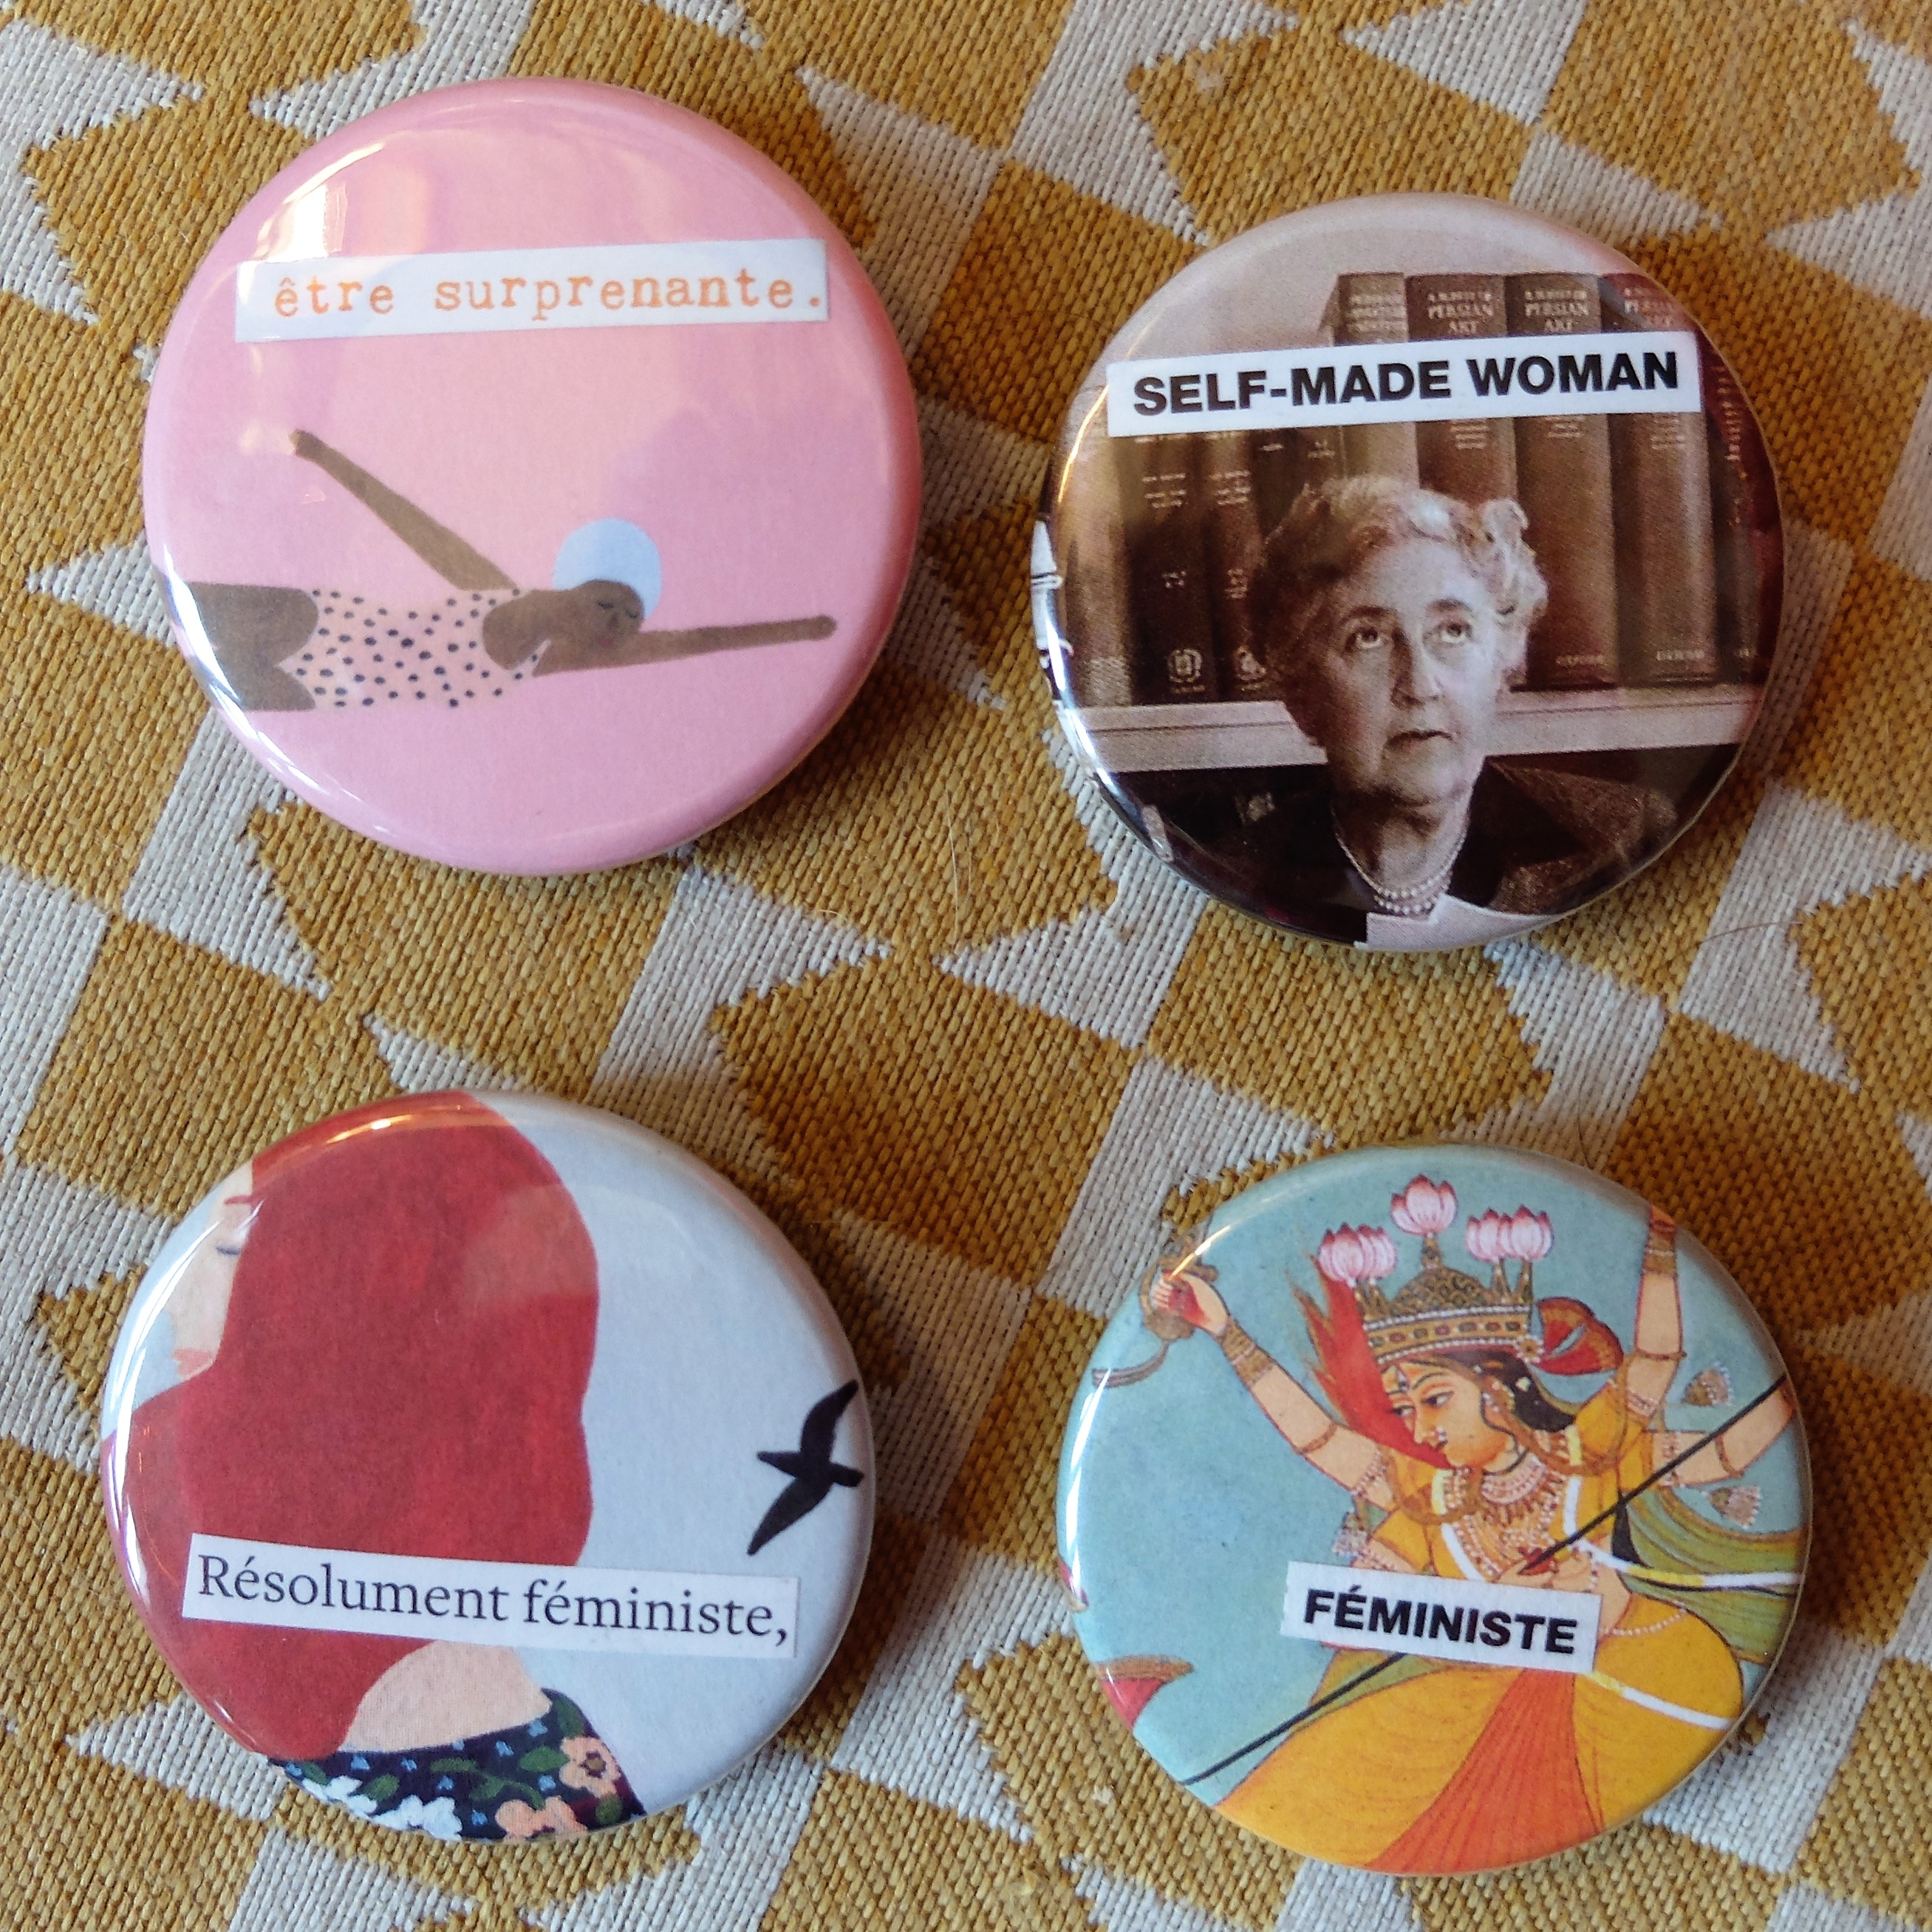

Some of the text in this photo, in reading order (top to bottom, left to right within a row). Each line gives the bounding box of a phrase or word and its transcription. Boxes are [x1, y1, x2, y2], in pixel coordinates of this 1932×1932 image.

[274, 268, 822, 322] être surprenante.
[1134, 350, 1679, 416] SELF-MADE WOMAN
[198, 1554, 788, 1647] Résolument féministe,
[1303, 1584, 1579, 1655] FÉMINISTE
